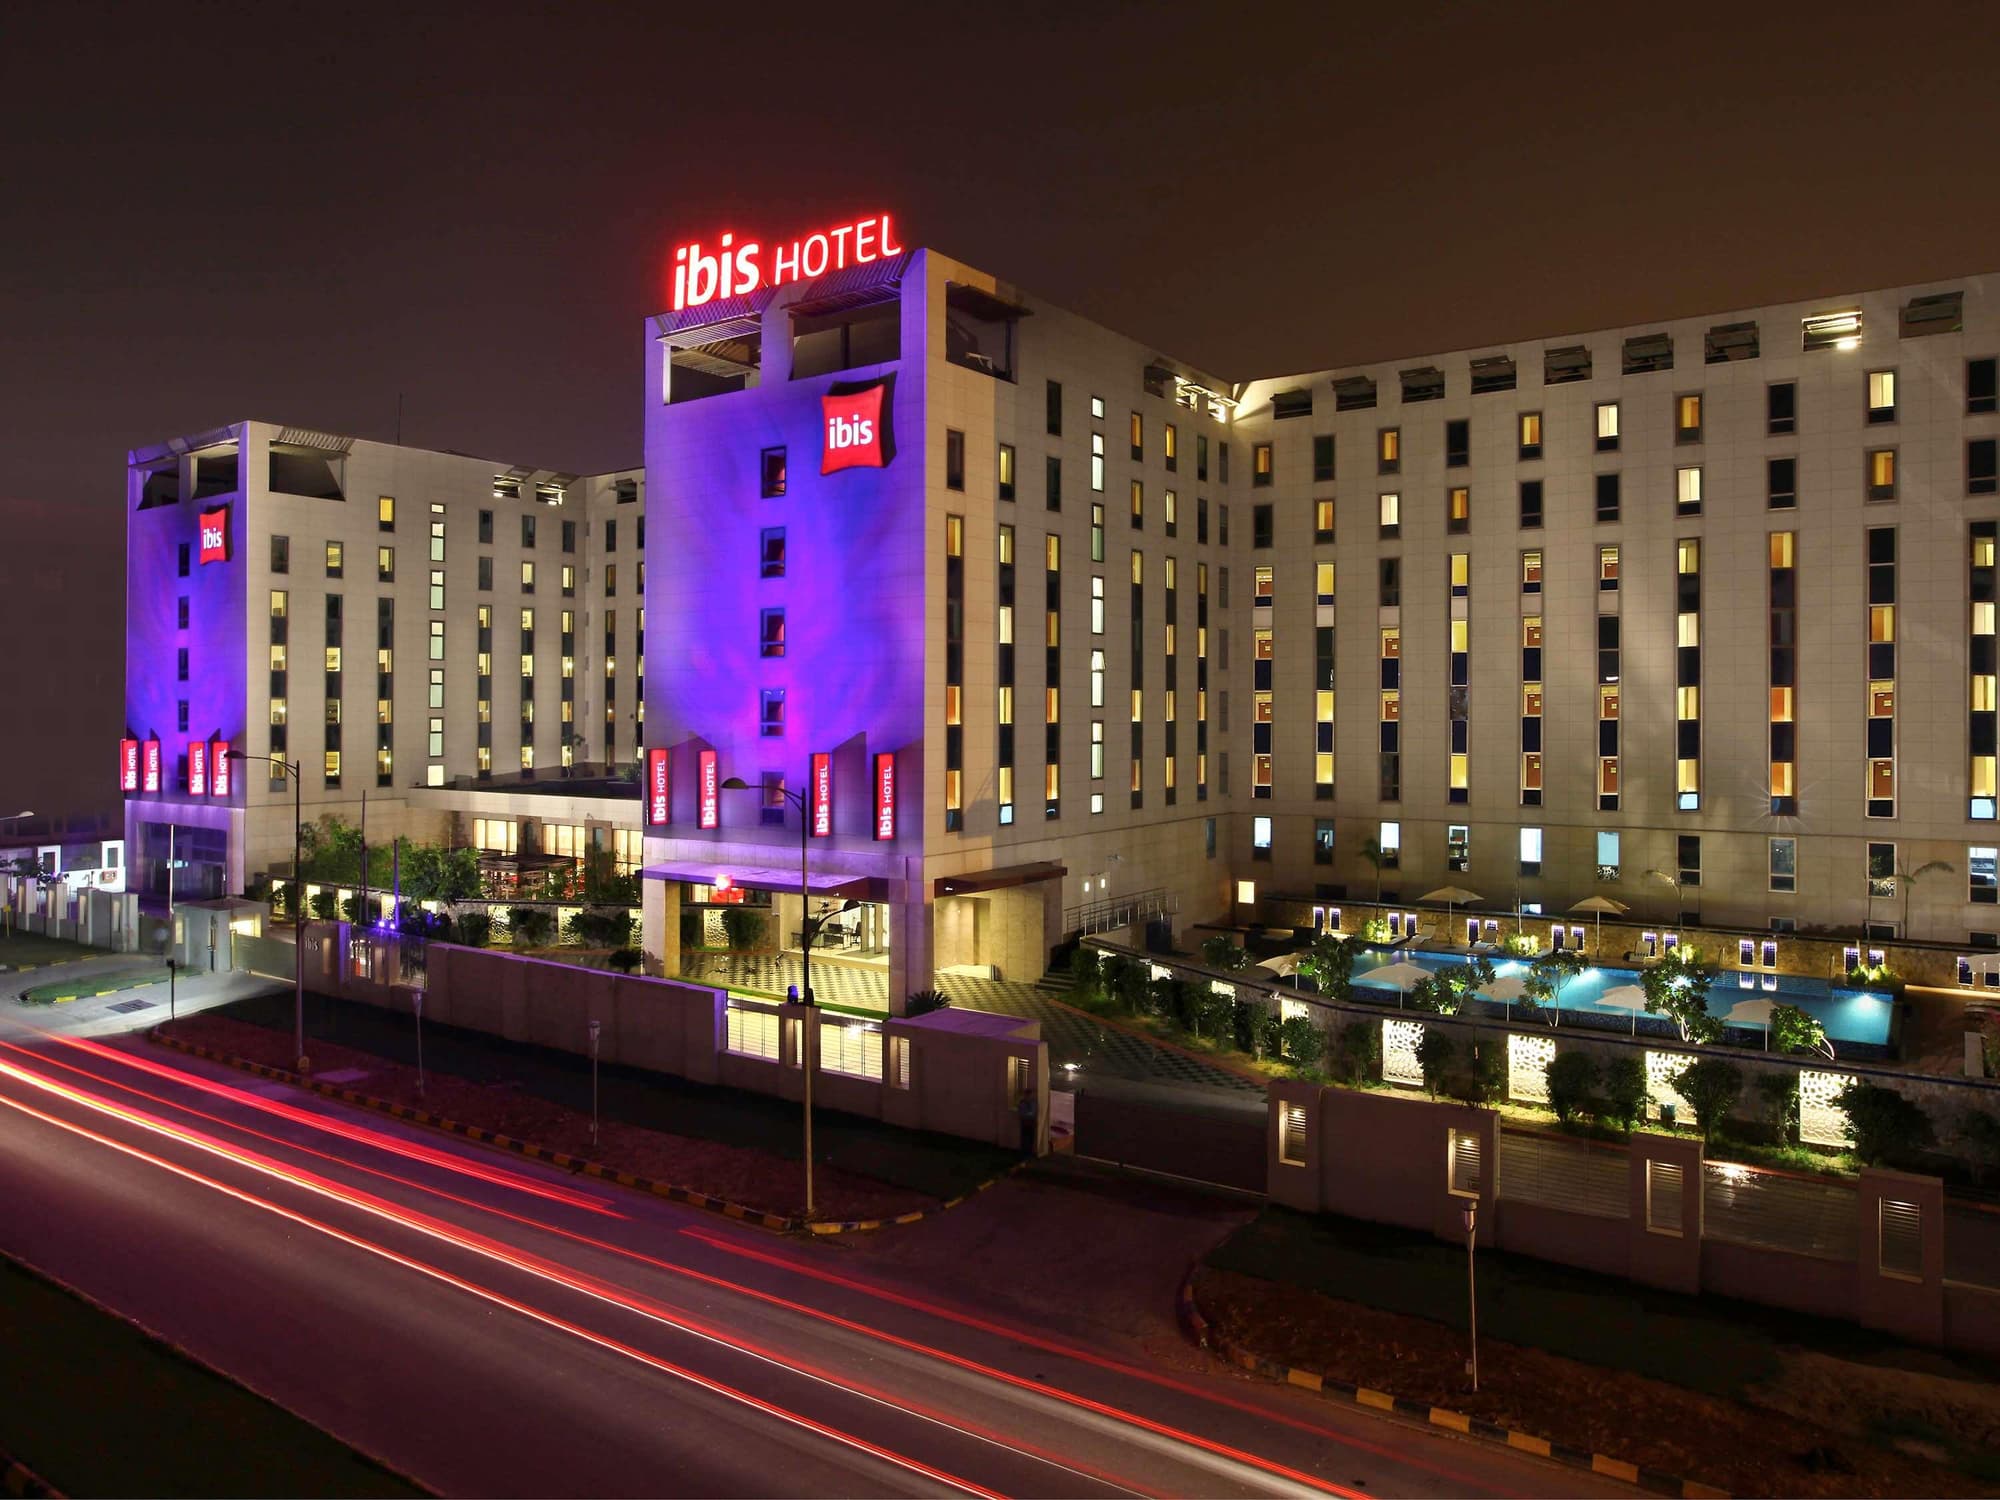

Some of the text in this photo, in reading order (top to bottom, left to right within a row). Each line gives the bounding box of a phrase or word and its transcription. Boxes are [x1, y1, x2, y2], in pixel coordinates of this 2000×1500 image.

[673, 215, 902, 311] ibis HOTEL
[829, 414, 873, 449] ibis
[203, 527, 222, 549] ibis
[125, 747, 137, 789] ibis HOTEL
[145, 748, 158, 791] ibis HOTEL
[191, 749, 204, 794] ibis HOTEL
[215, 774, 228, 795] ibis
[653, 760, 666, 822] ibis HOTEL
[703, 761, 715, 826] ibis HOTEL
[816, 765, 829, 833] ibis HOTEL
[880, 766, 892, 836] ibis HOTEL
